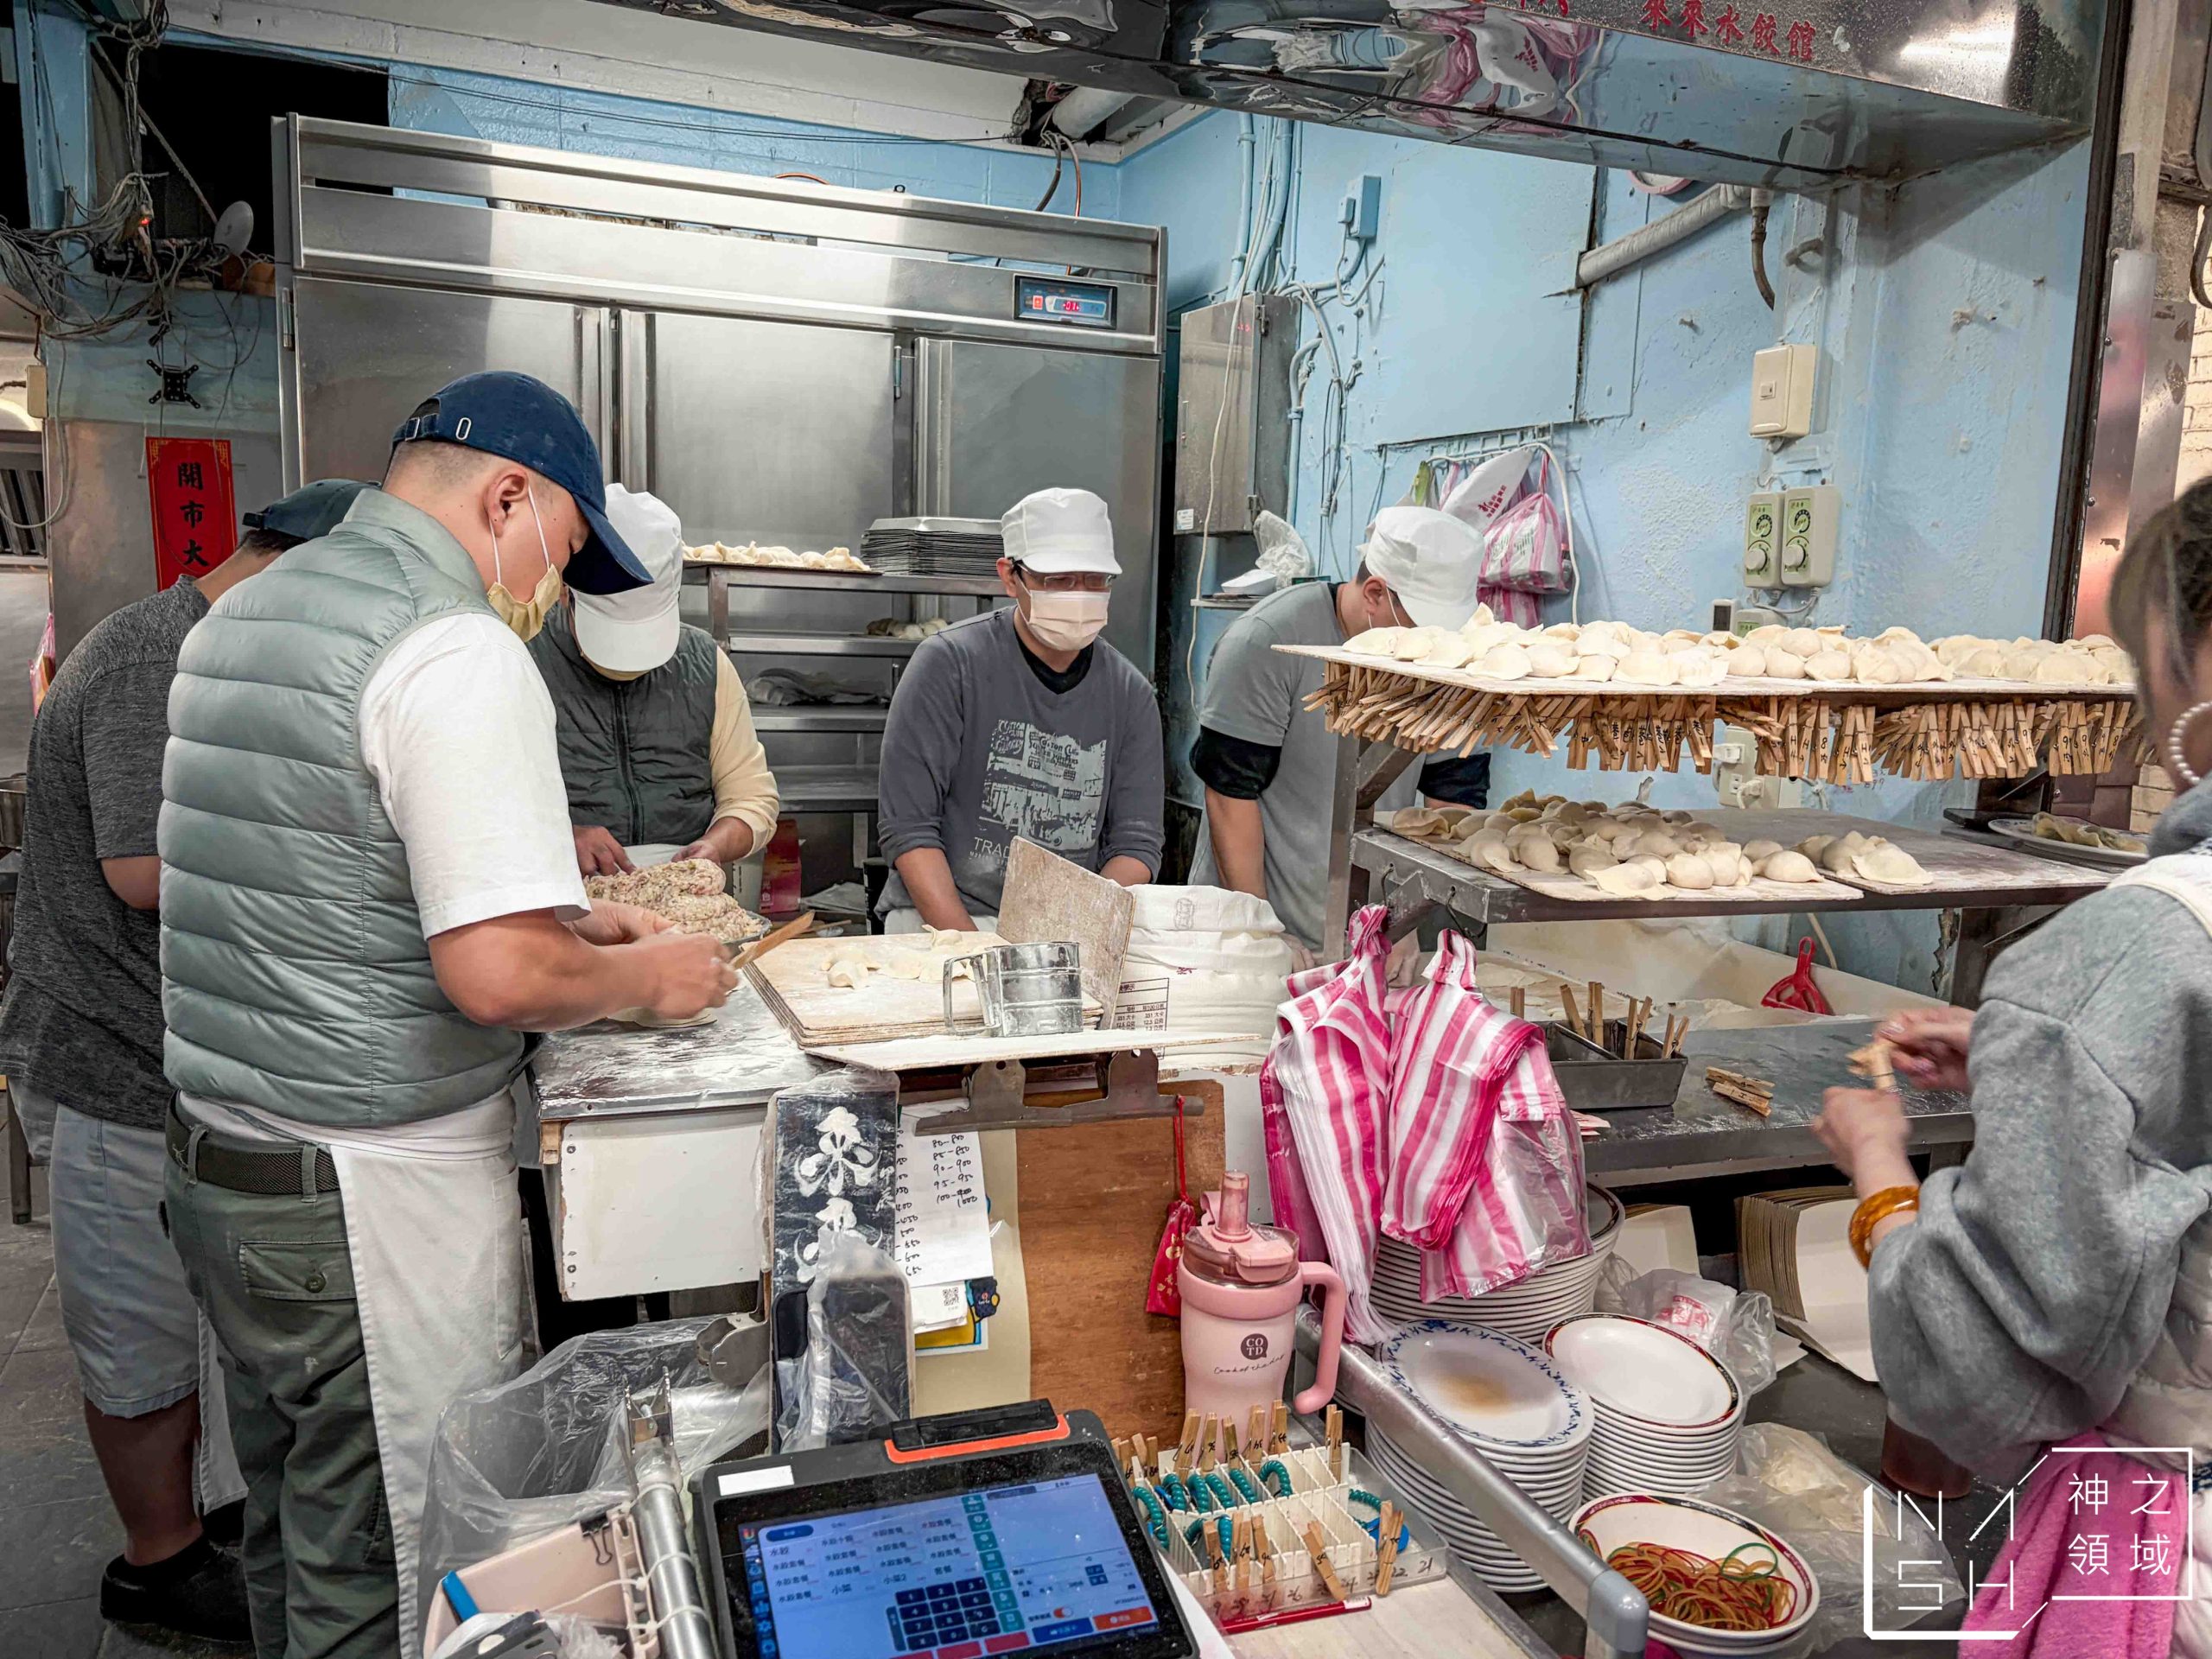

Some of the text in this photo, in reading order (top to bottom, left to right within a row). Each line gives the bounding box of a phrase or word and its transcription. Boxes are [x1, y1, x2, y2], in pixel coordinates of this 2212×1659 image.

[177, 462, 209, 567] 開市大
[1246, 1338, 1263, 1347] CO
[1246, 1347, 1263, 1356] TD
[1417, 1556, 1433, 1575] 21
